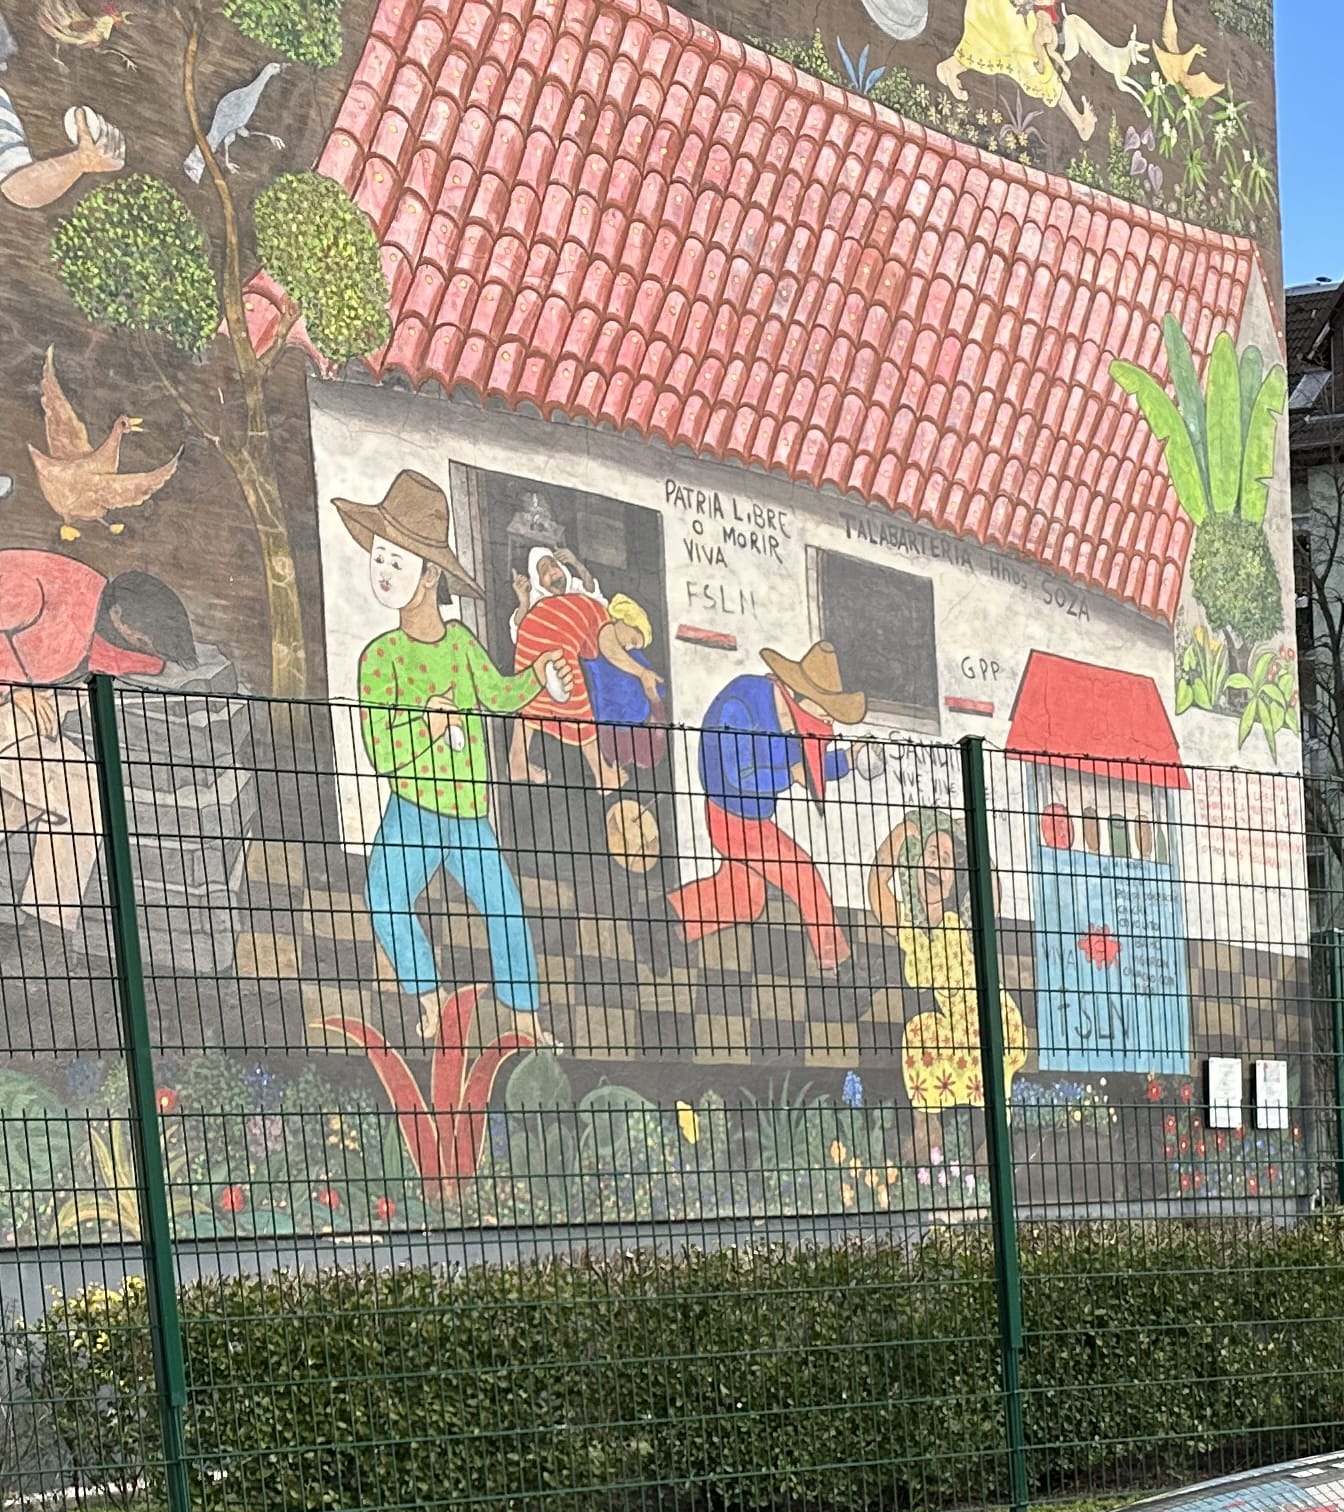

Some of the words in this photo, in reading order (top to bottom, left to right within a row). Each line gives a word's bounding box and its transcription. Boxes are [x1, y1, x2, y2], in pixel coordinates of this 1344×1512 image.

[665, 479, 724, 520] PATRIA
[683, 538, 728, 568] VIVA
[722, 526, 783, 564] MORIR
[839, 511, 974, 571] TALABARTERIA
[1041, 578, 1090, 622] SOZA
[960, 656, 1000, 682] GPP
